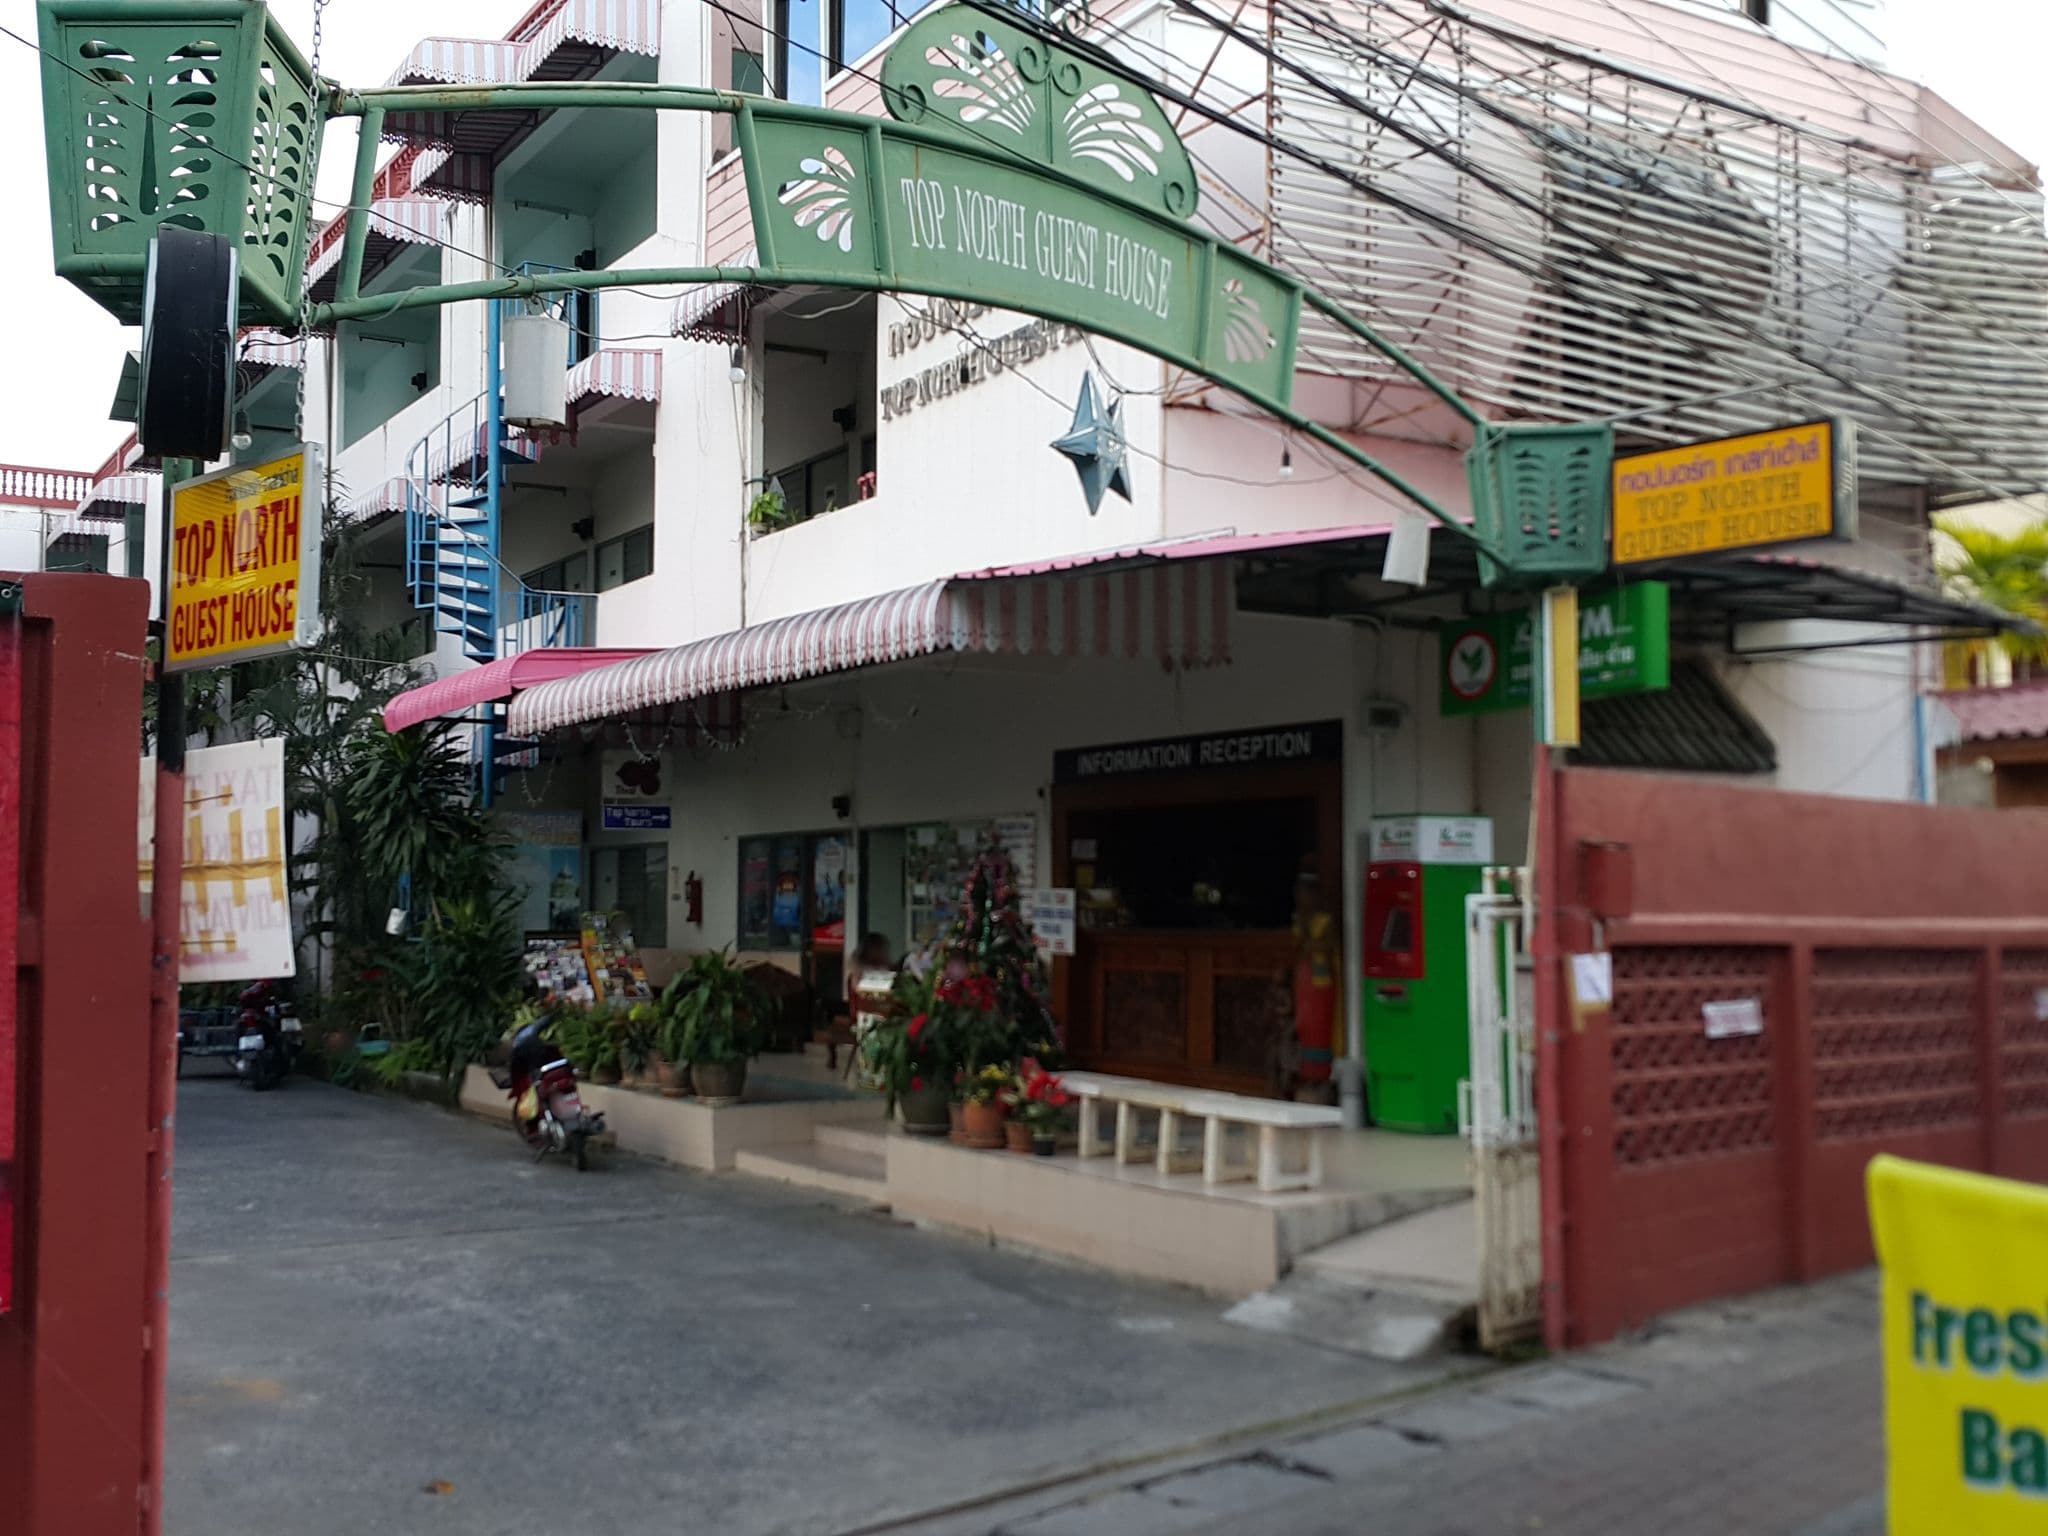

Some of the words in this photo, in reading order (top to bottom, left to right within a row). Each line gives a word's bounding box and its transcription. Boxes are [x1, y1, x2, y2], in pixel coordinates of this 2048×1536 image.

[901, 178, 946, 249] TOP
[954, 185, 1028, 270] NORTH
[1035, 211, 1099, 290] GUEST
[1104, 232, 1173, 320] HOUSE
[1620, 519, 1711, 556] GUEST
[1722, 501, 1822, 543] HOUSE
[1638, 489, 1688, 524] TOP
[1699, 472, 1802, 513] NORTH
[175, 520, 216, 589] TOP
[220, 495, 299, 579] NORTH
[173, 593, 228, 654] GUEST
[232, 580, 295, 642] HOUSE
[1078, 744, 1190, 776] INFORMATION
[1198, 732, 1311, 763] RECEPTION
[1911, 1290, 2048, 1379] Fres
